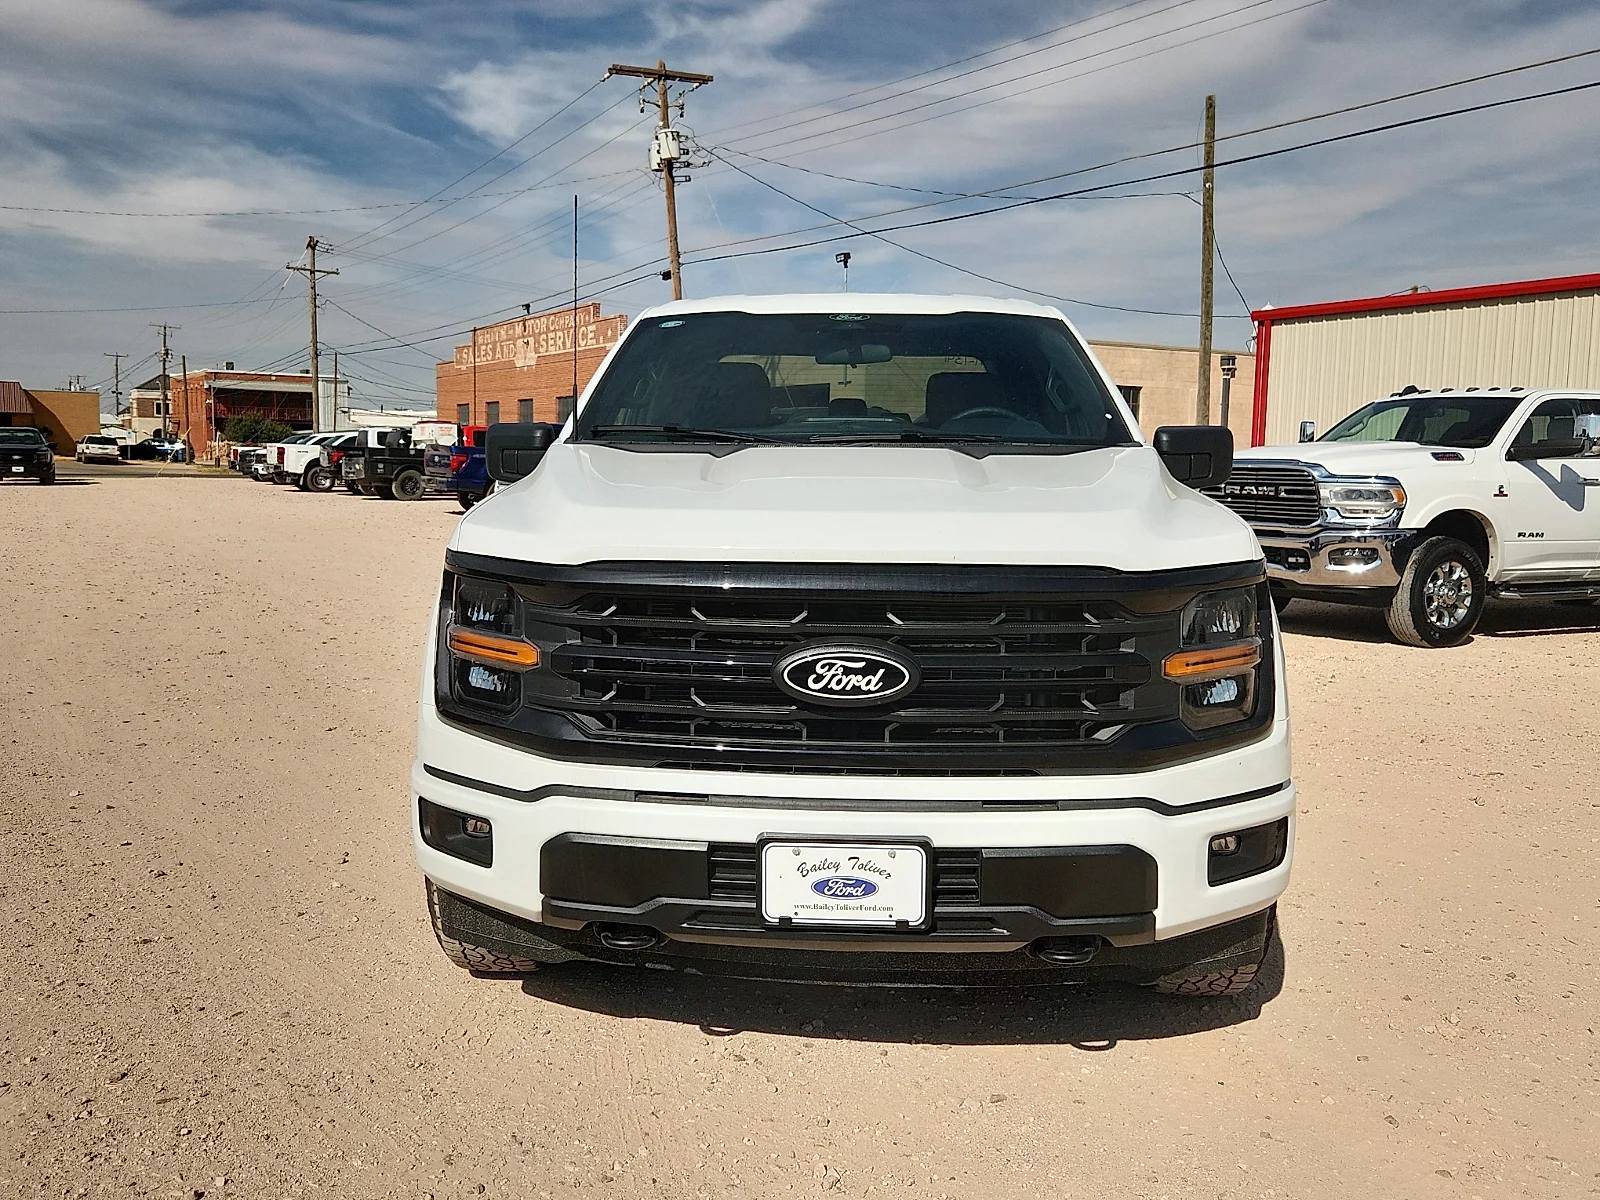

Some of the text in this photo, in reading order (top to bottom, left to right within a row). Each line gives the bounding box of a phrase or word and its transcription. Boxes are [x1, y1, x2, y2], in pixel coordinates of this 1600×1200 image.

[515, 316, 547, 337] MOTOR
[462, 344, 493, 364] SALES
[1226, 485, 1275, 496] RAM
[807, 659, 886, 692] Ford
[797, 856, 892, 880] Bailey Toliver
[824, 878, 866, 897] Ford
[793, 903, 894, 912] www.BaileyToliverFord.com
